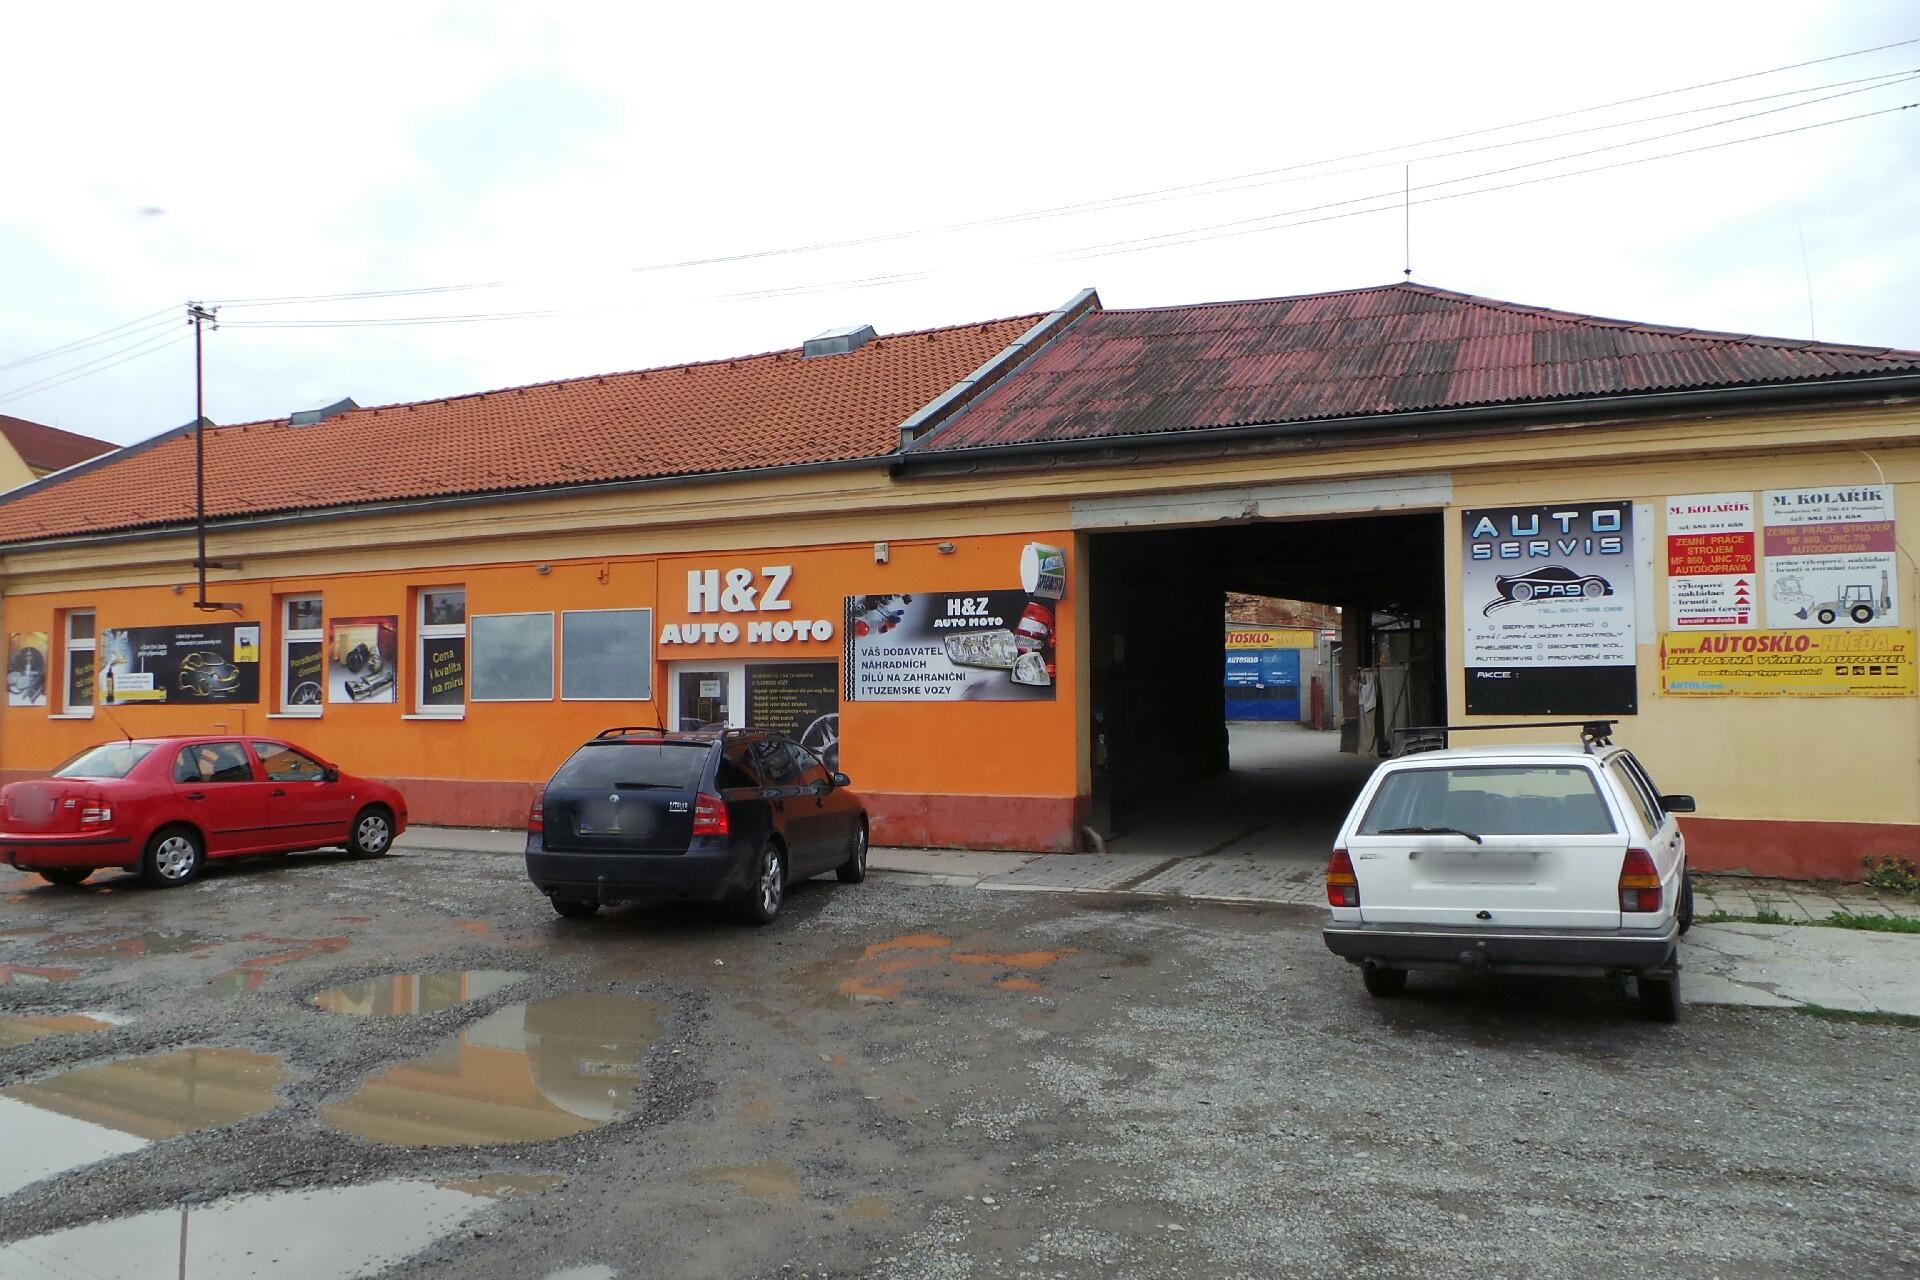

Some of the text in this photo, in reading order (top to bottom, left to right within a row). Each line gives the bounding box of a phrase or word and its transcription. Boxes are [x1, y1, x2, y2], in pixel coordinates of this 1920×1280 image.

[1773, 487, 1883, 506] M. KOLAŘÍK
[1670, 501, 1750, 515] M. KOLAŘÍK
[1472, 509, 1622, 539] AUTO
[1843, 522, 1891, 532] STROJEM
[1675, 536, 1705, 546] ZEMNÍ
[1786, 536, 1801, 545] MF
[1829, 534, 1851, 544] UNC
[1472, 537, 1622, 560] SERVIS
[1687, 545, 1734, 555] STROJEM
[1791, 543, 1867, 554] AUTODOPRAVA
[1670, 556, 1685, 565] MF
[1711, 554, 1732, 563] UNC
[1735, 553, 1752, 563] 750
[1675, 563, 1748, 574] AUTODOPRAVA
[688, 566, 793, 613] H&Z
[947, 597, 989, 616] H&Z
[933, 617, 1004, 628] AUTO MOTO
[660, 619, 834, 644] AUTO MOTO
[432, 649, 455, 664] Cena
[861, 646, 944, 657] VÁŠ DODAVATEL
[861, 659, 927, 670] NÁHRADNÍCH
[1667, 654, 1906, 666] BEZPLATNÁ VÝMĚNA AUTOSKEL
[434, 662, 462, 678] kvalita
[1476, 671, 1512, 679] AKCE
[861, 671, 966, 683] DÍLŮ NA ZAHRANIČNÍ
[432, 683, 443, 694] na
[867, 685, 922, 695] TUZEMSKÉ
[924, 685, 952, 695] VOZY
